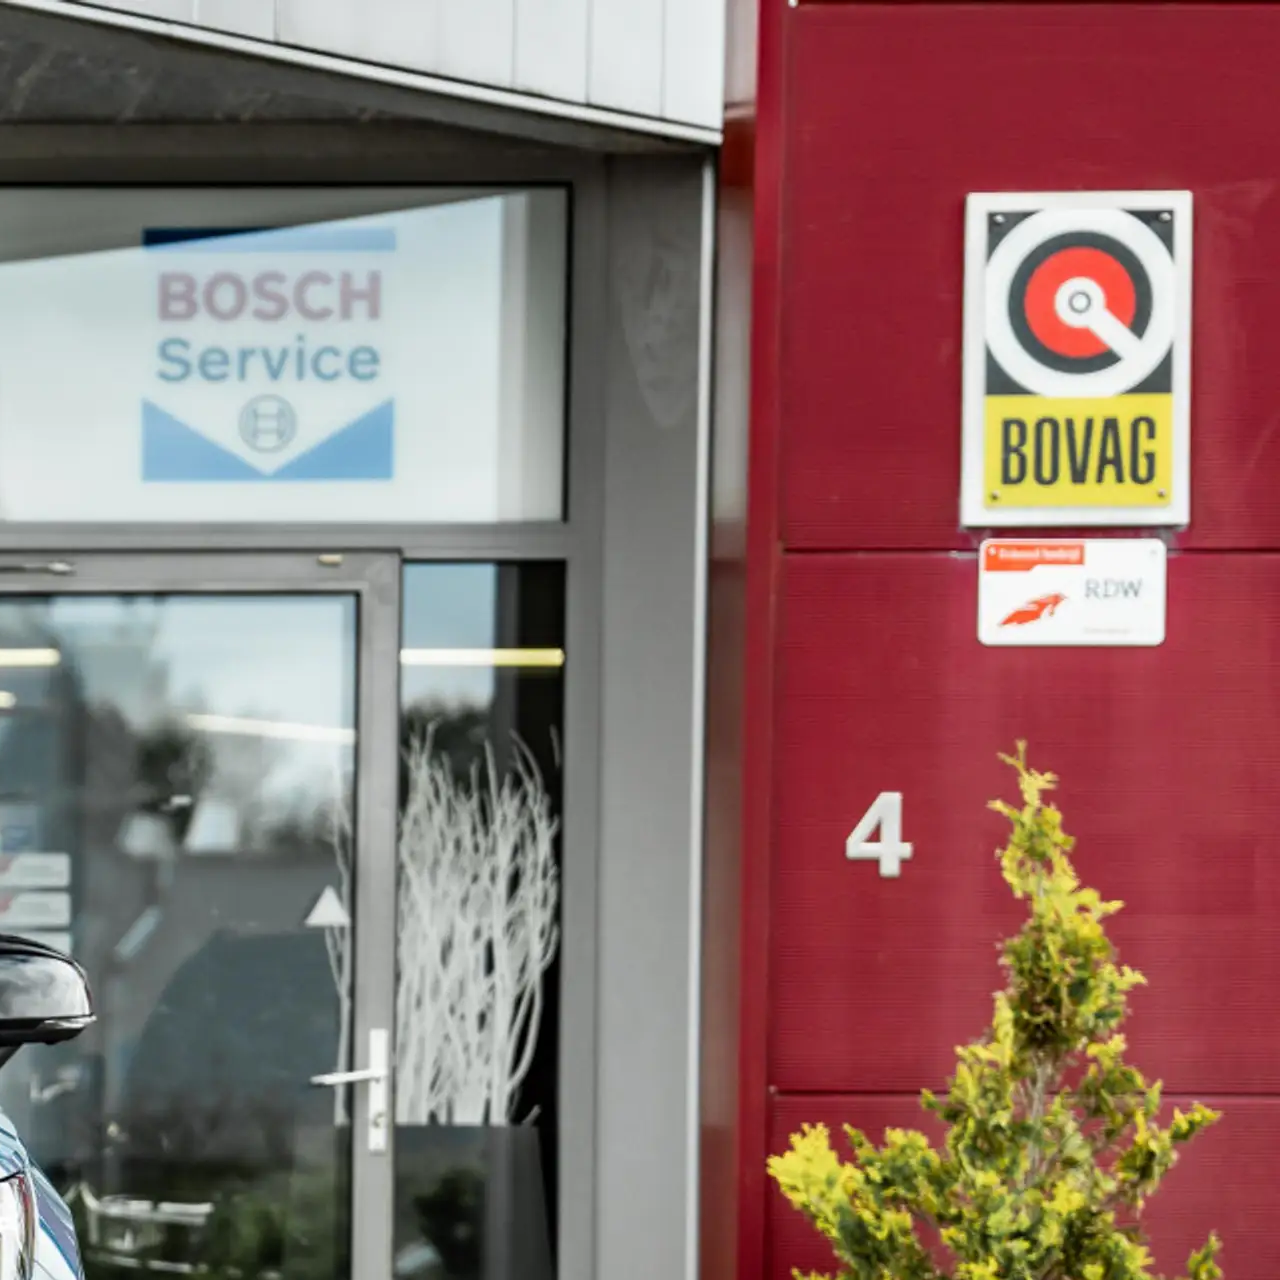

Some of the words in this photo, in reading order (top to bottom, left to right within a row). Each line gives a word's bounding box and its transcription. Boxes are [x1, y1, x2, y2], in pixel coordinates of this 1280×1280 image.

[156, 270, 383, 322] BOSCH
[155, 334, 382, 383] Service
[1001, 415, 1158, 487] BOVAG
[1085, 579, 1143, 599] RDW
[845, 791, 914, 877] 4
